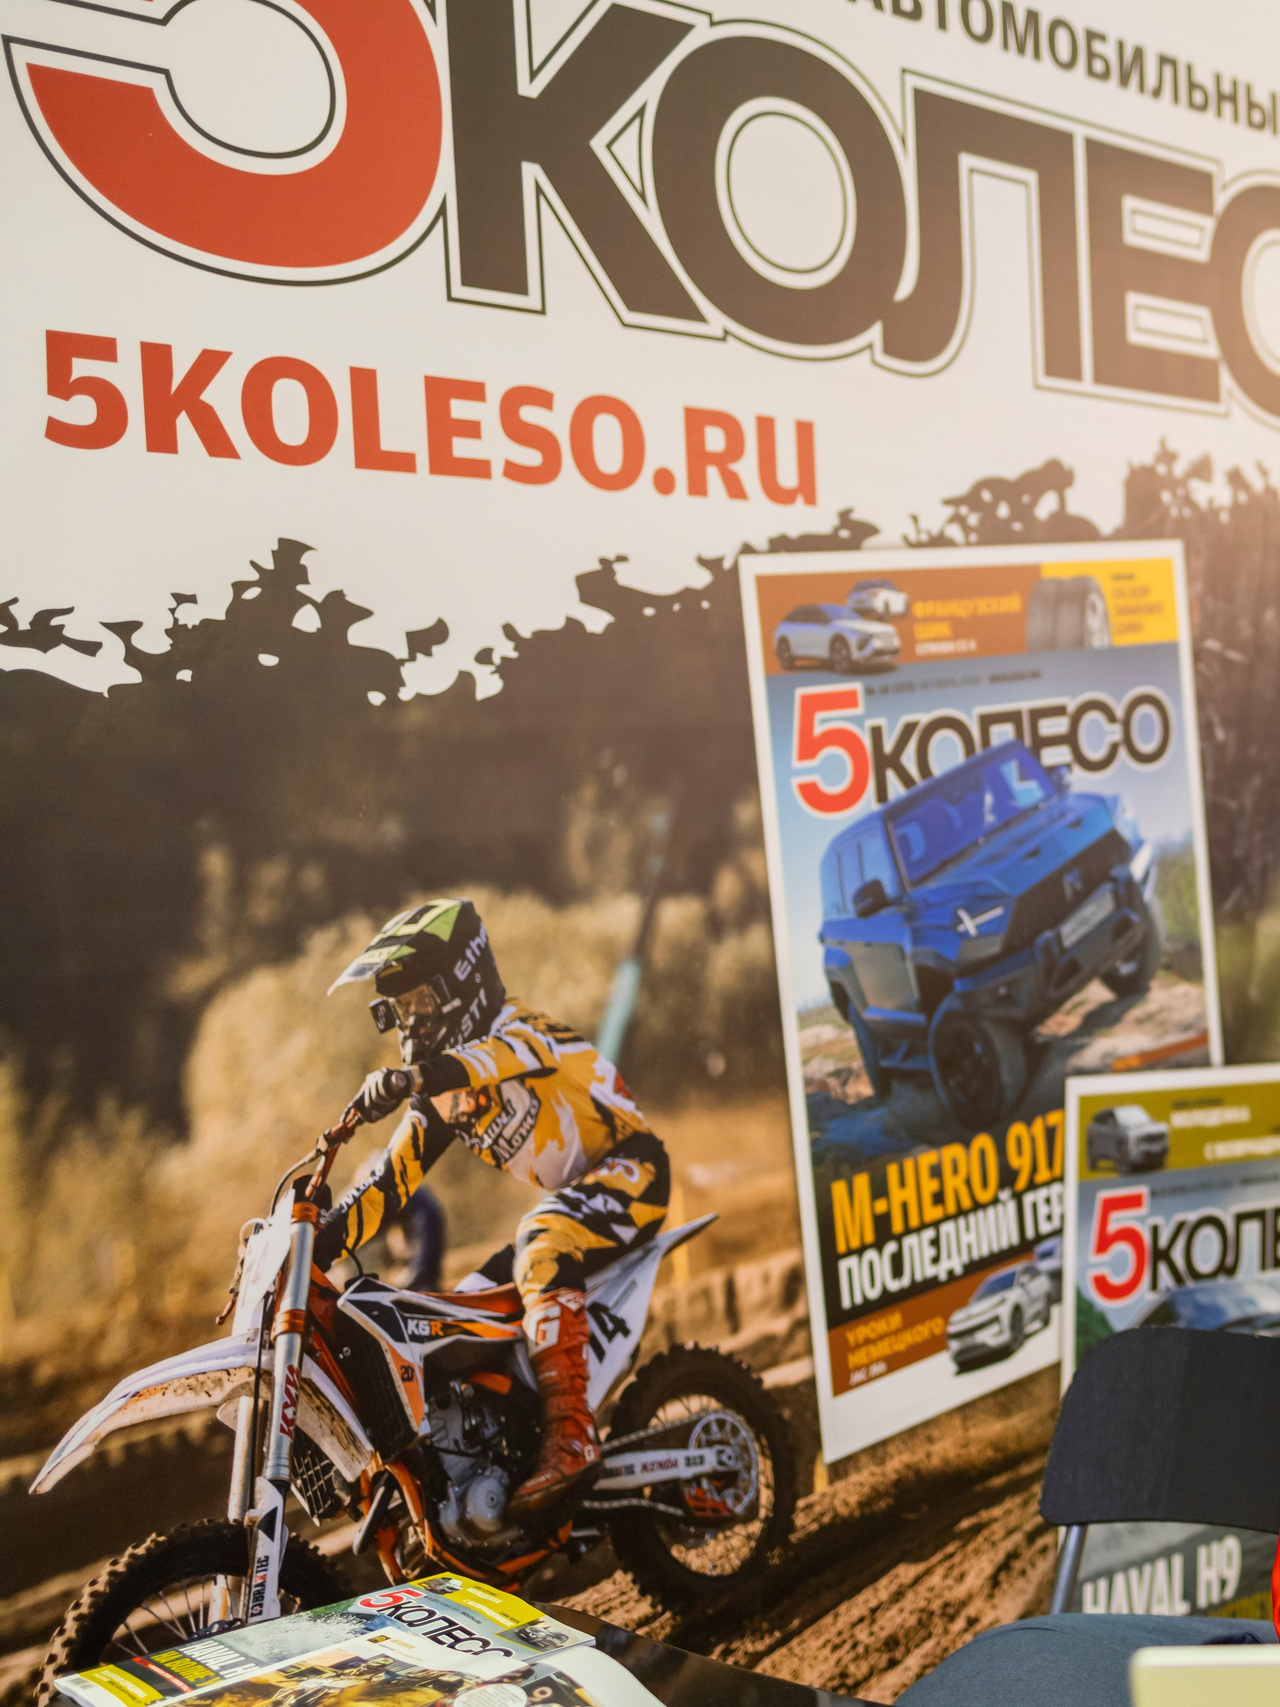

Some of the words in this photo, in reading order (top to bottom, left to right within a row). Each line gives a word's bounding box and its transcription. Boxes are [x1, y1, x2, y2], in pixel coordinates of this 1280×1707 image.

[44, 329, 819, 507] 5KOLESO.RU
[794, 684, 1172, 816] 5КОЛЕСО
[830, 1132, 999, 1255] M-HERO
[1006, 1107, 1065, 1192] 917
[838, 1186, 1020, 1311] ПОСЛЕДНИЙ
[1082, 1552, 1192, 1616] HAVAL
[1196, 1534, 1243, 1609] H9
[179, 1640, 246, 1671] HAVAL
